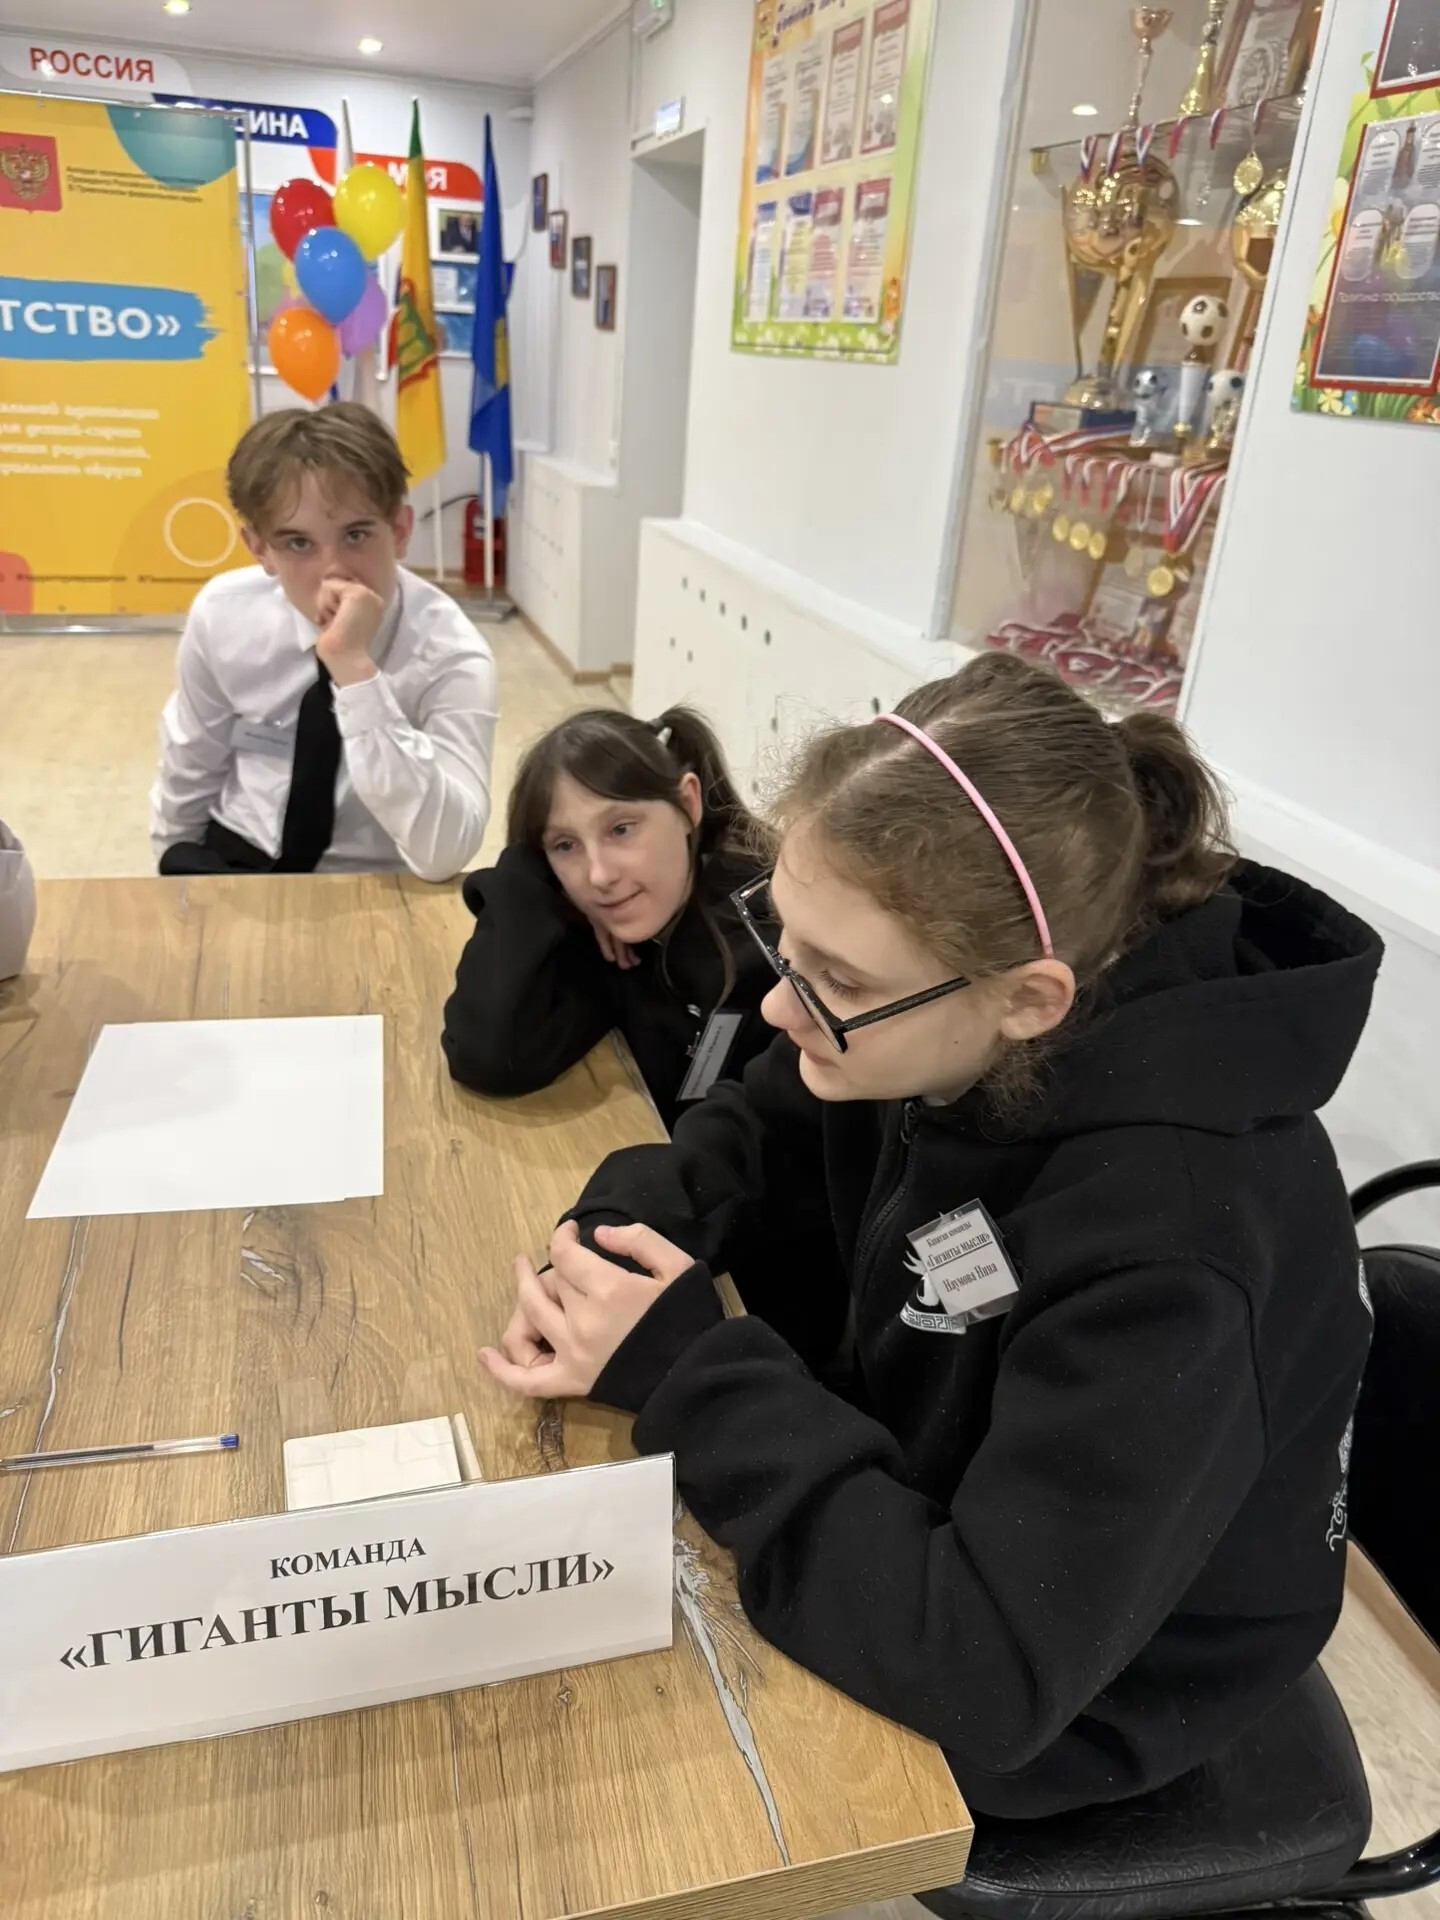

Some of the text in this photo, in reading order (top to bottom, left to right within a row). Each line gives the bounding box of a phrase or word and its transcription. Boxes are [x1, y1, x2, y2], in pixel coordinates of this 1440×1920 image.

[29, 47, 155, 83] РОССИЯ
[271, 1537, 427, 1579] КОМАНДА
[60, 1553, 615, 1670] «ГИГАНТЫ МЫСЛИ»
